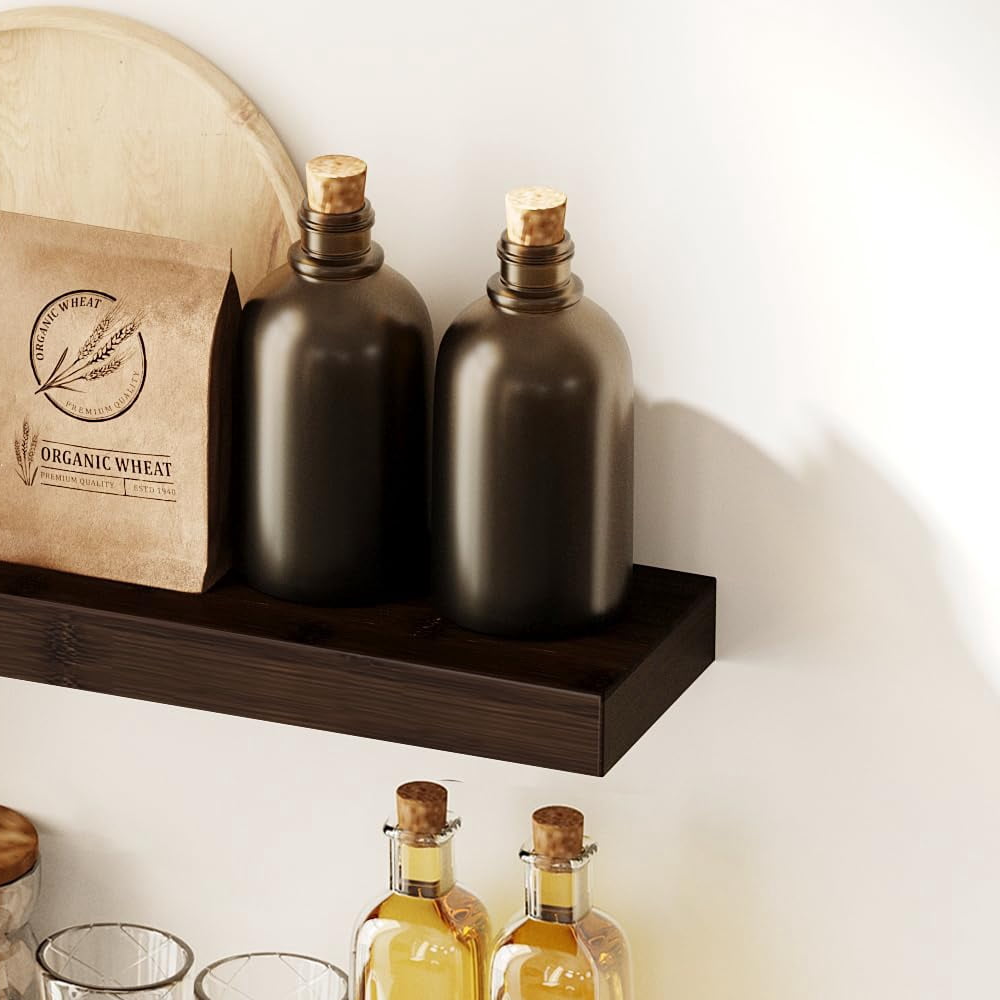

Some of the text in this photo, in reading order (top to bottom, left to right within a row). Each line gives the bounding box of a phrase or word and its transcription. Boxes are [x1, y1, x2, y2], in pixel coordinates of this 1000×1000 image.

[36, 297, 102, 361] ORGANIC WHEAT
[65, 371, 140, 415] PREMIUM QUALITY
[40, 471, 115, 489] PREMIUM QUALITY
[41, 446, 172, 477] ORGANIC WHEAT
